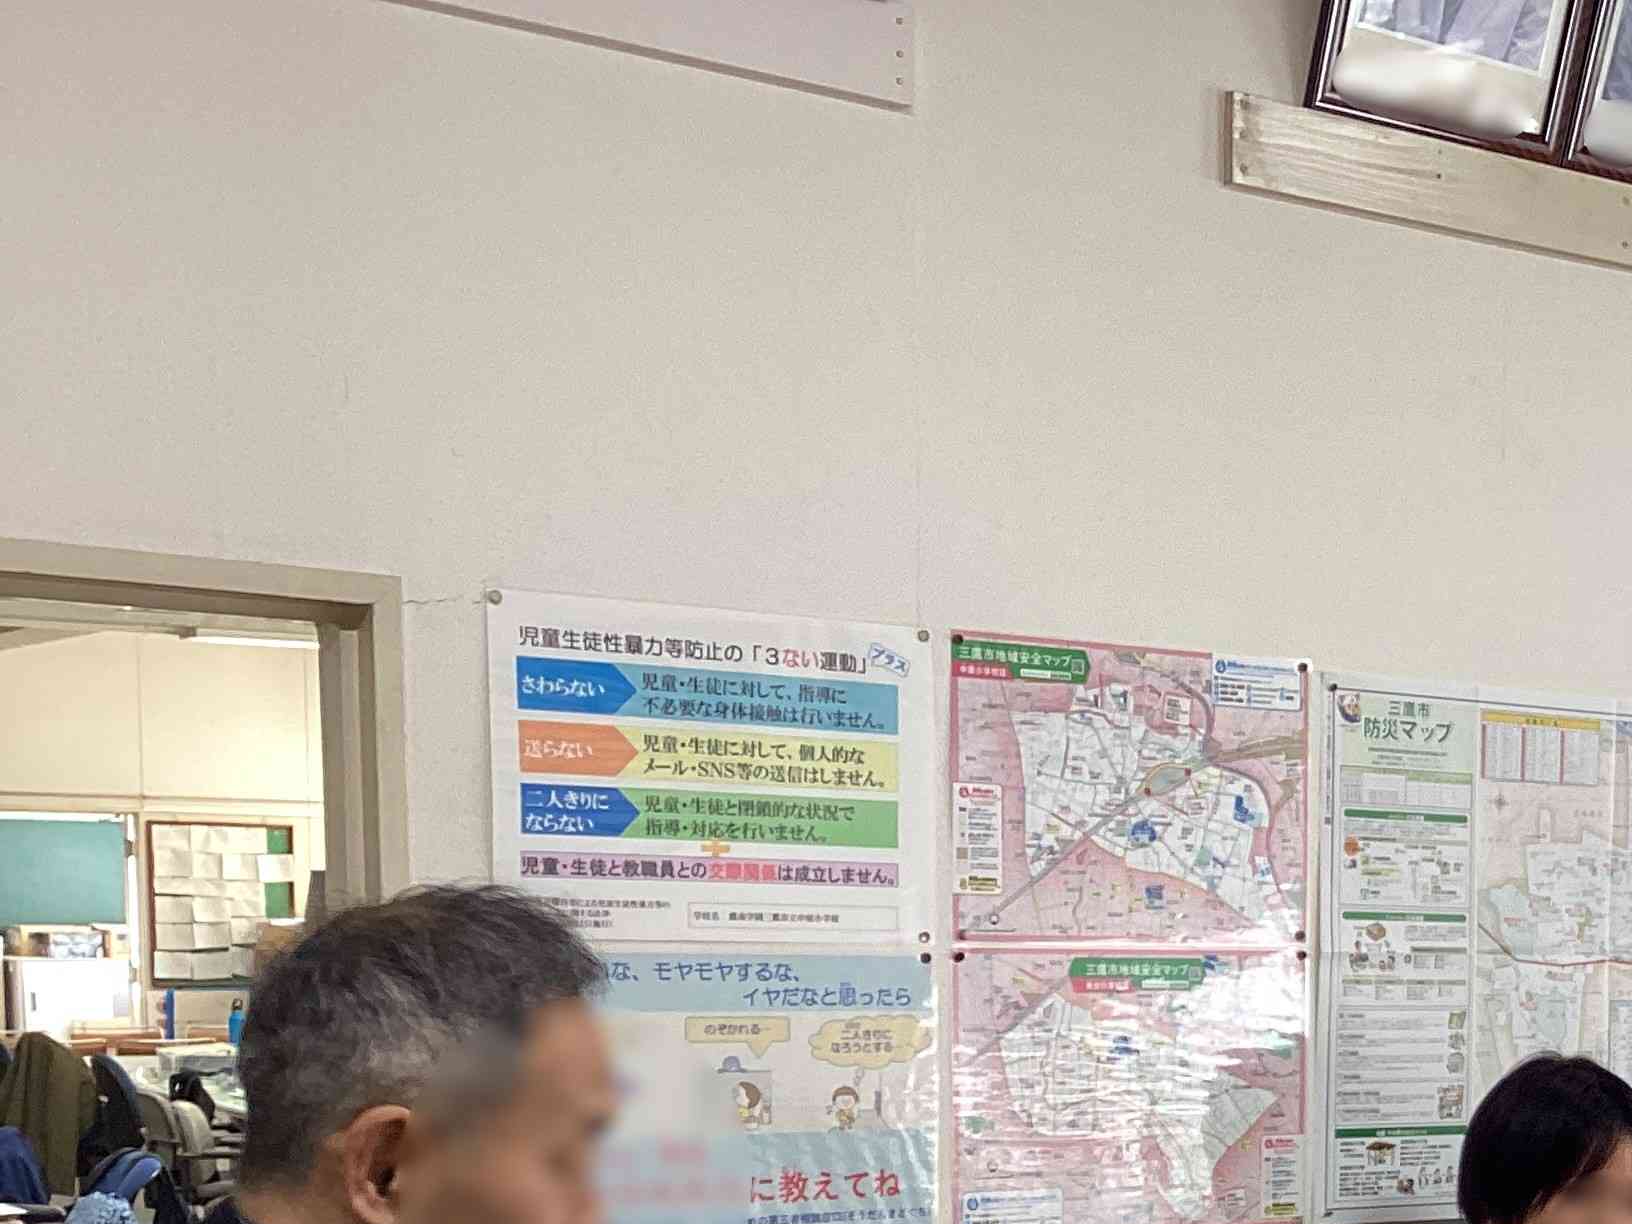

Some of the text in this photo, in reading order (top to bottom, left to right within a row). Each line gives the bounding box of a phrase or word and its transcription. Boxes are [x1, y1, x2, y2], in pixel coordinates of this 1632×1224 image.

[872, 646, 907, 673] プラス
[521, 673, 606, 698] さわらない
[642, 671, 848, 705] 児童・生徒に対して、指導に
[643, 695, 886, 730] 不必要な身体接触は行いません。
[1388, 700, 1430, 718] 三鷹市
[1363, 717, 1452, 743] 防災マップ
[523, 738, 594, 759] 送らない
[643, 733, 866, 765] 児童・生徒に対して、個人的な
[643, 757, 885, 788] メール・SNS等の送信はしません。
[525, 789, 611, 810] 二人きりに
[645, 795, 856, 821] 児童・生徒と閉鎖的な状況で
[525, 812, 595, 833] ならない
[645, 817, 828, 842] 指導・対応を行いません。
[604, 962, 801, 982] な、モヤモヤするな、
[743, 988, 912, 1007] イヤだなと思ったら
